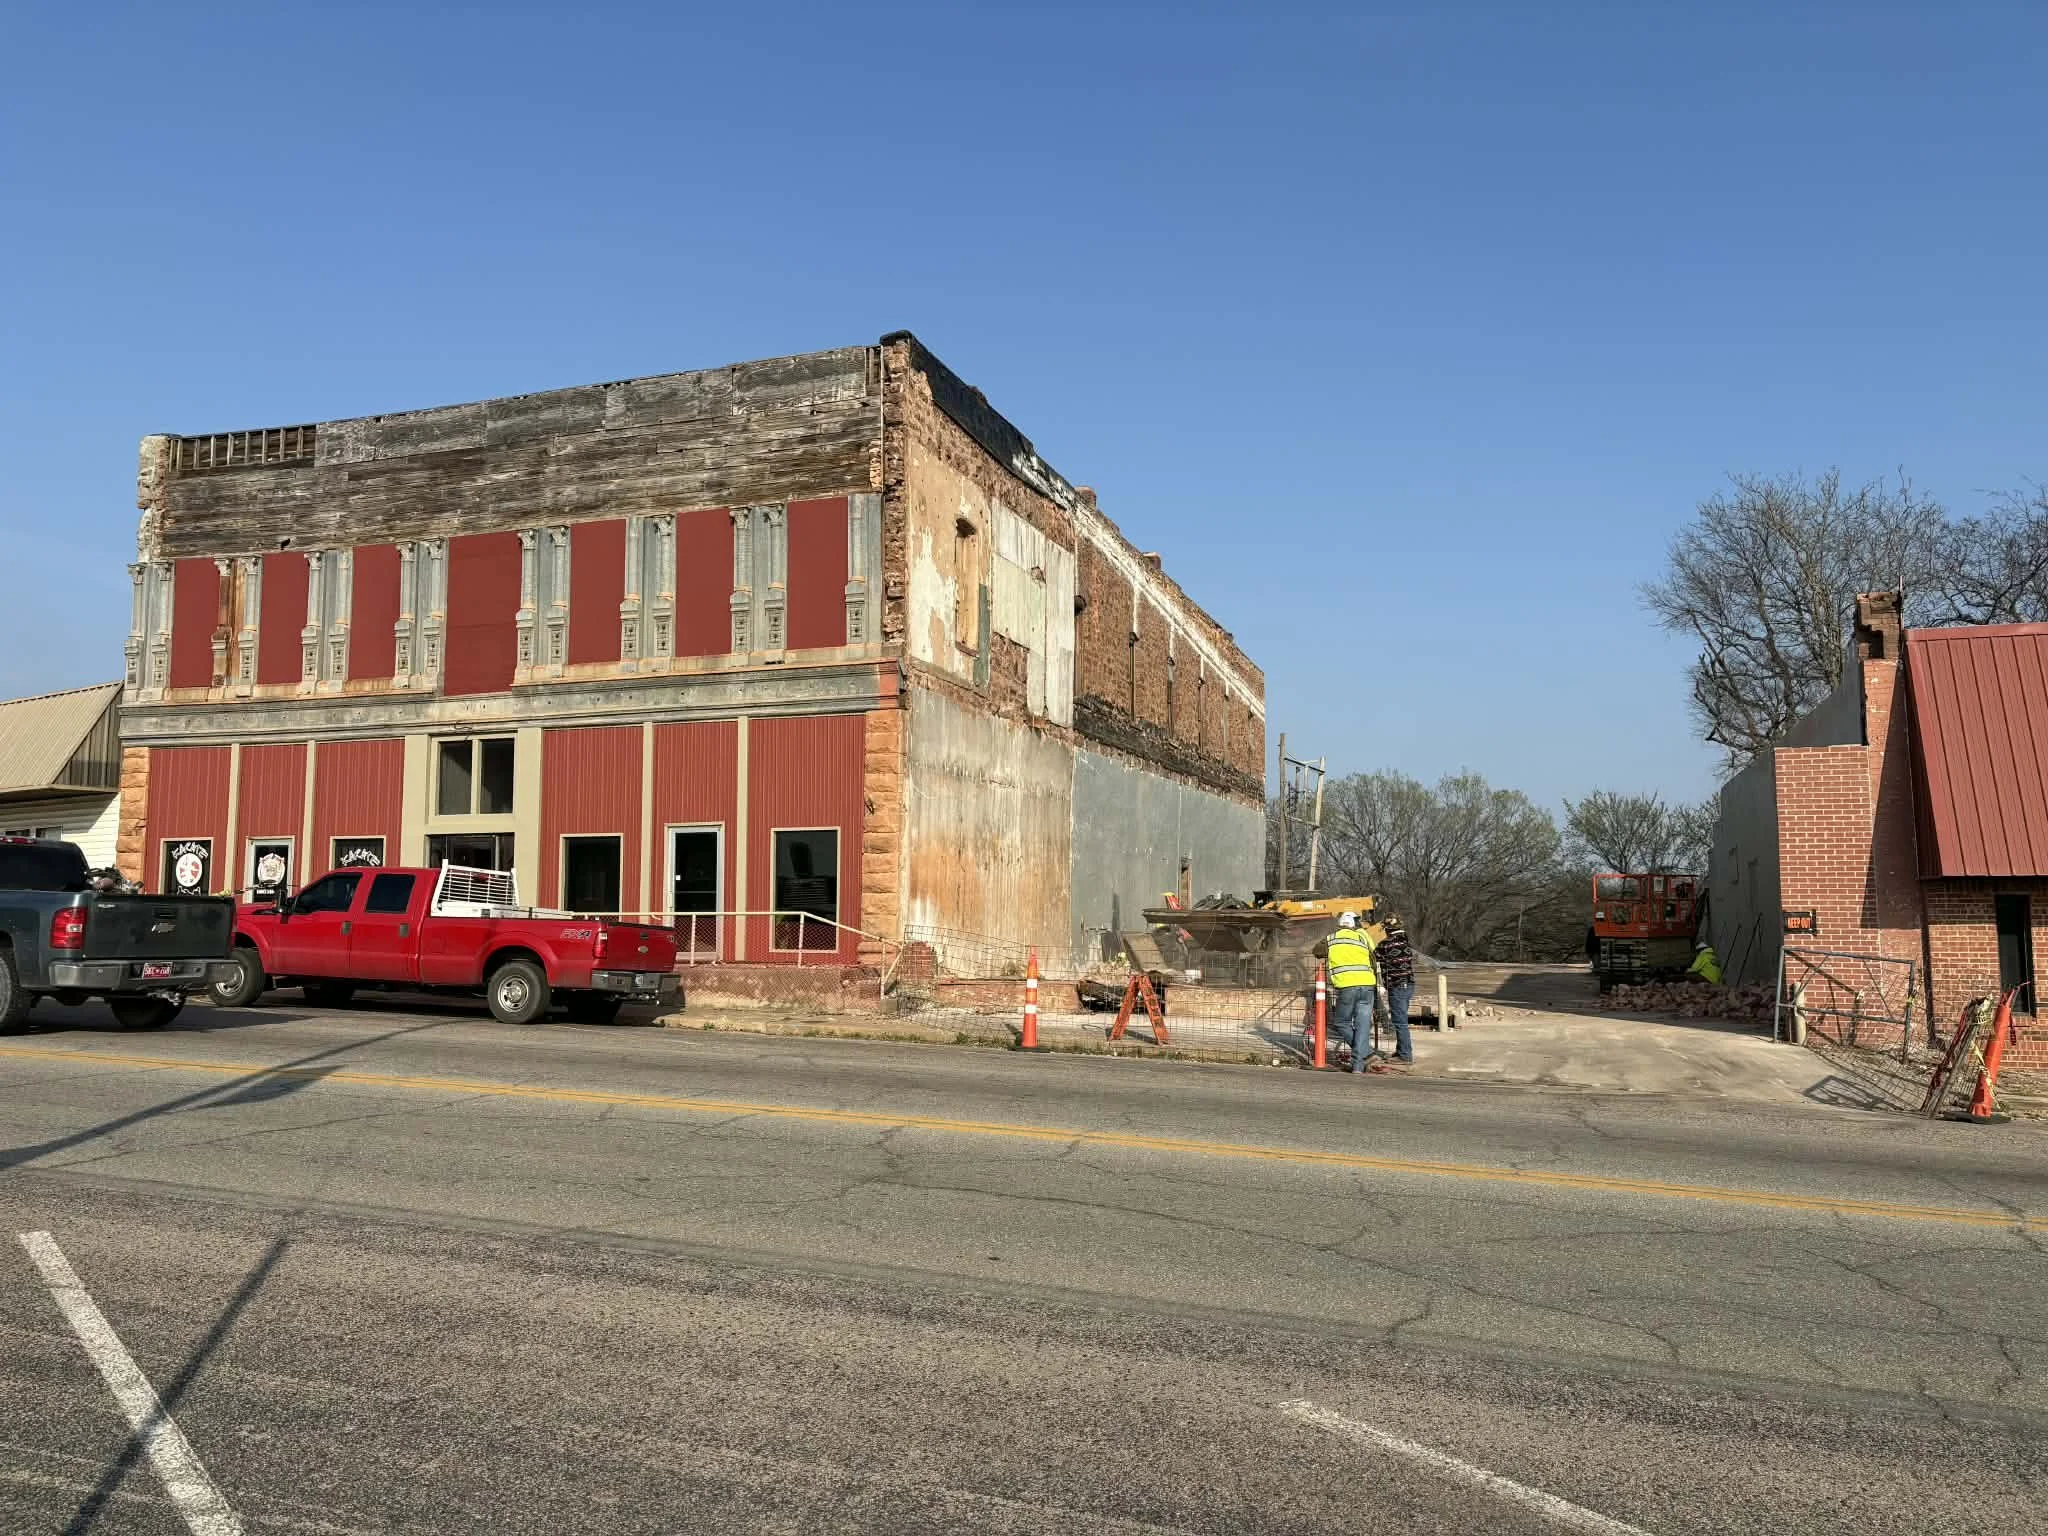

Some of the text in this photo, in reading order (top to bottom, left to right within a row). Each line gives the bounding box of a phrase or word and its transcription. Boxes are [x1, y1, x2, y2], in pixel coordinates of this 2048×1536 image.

[172, 842, 208, 859] KARATE
[340, 848, 380, 866] KARATE
[1787, 917, 1811, 928] KEEP OUT
